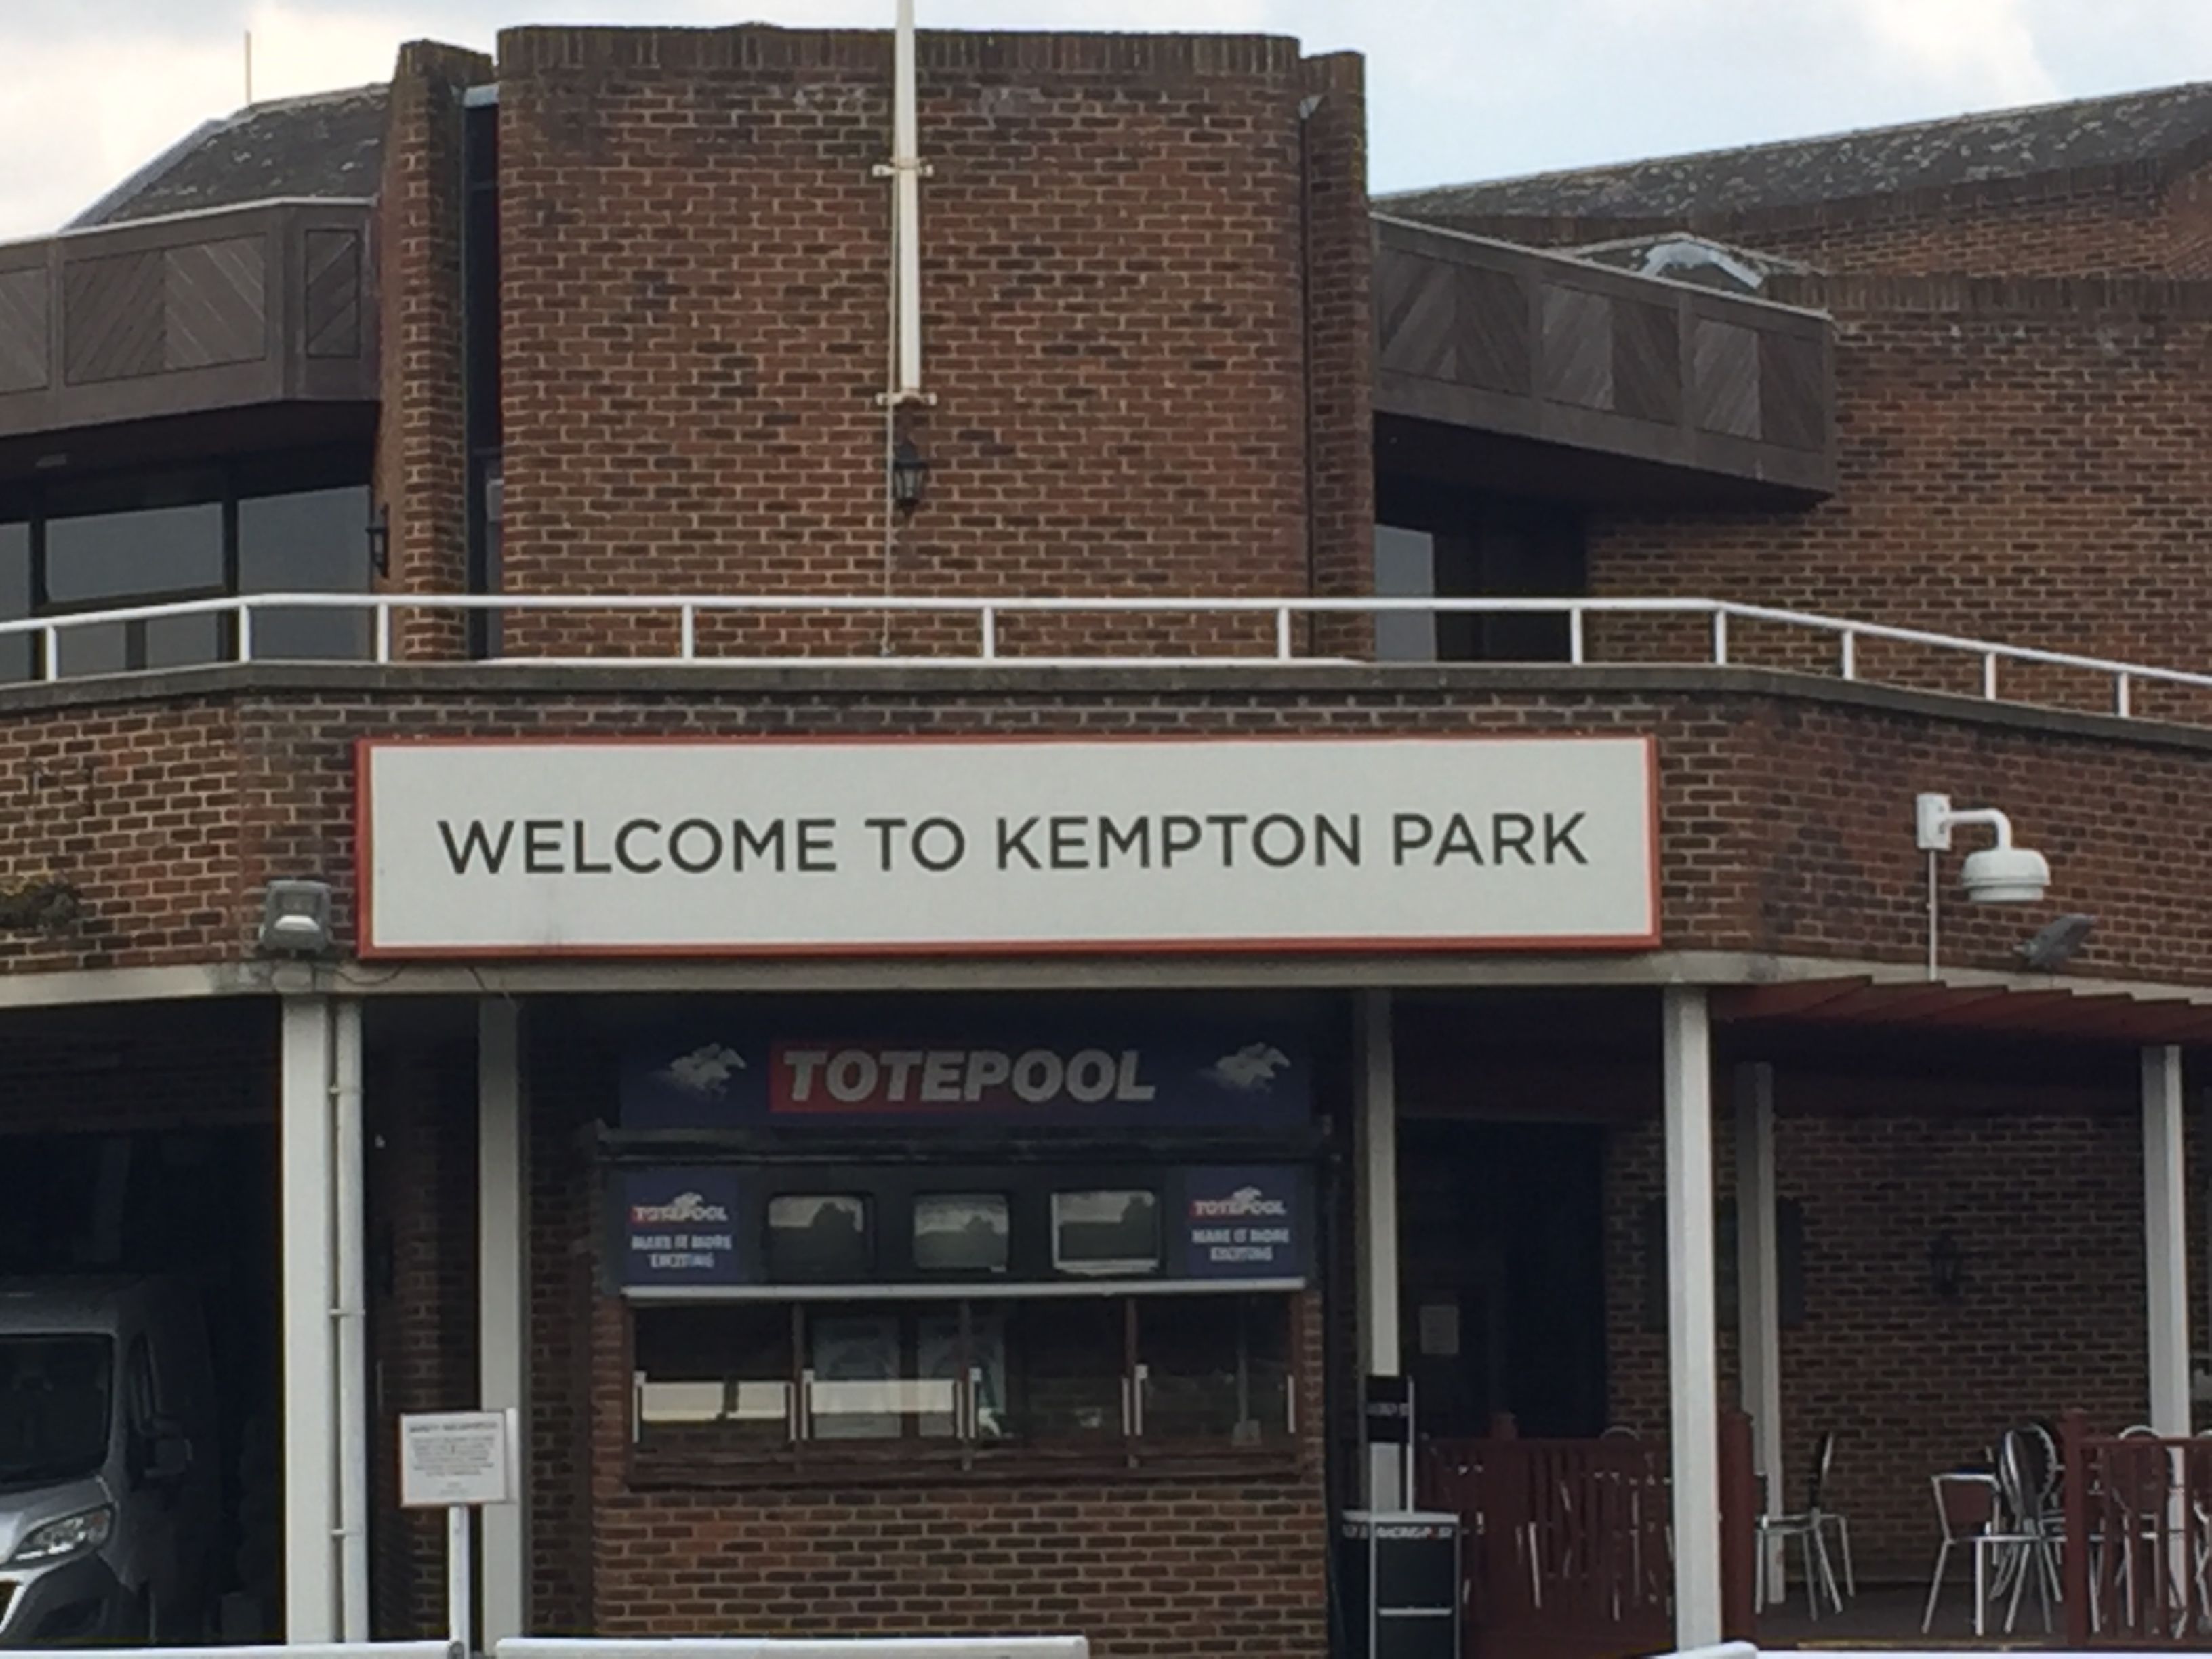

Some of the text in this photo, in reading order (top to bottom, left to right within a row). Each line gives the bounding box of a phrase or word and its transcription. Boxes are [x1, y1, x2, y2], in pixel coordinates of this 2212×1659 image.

[438, 812, 1589, 874] WELCOME TO KEMPTON PARK
[784, 1049, 1155, 1102] TOTEPOOL
